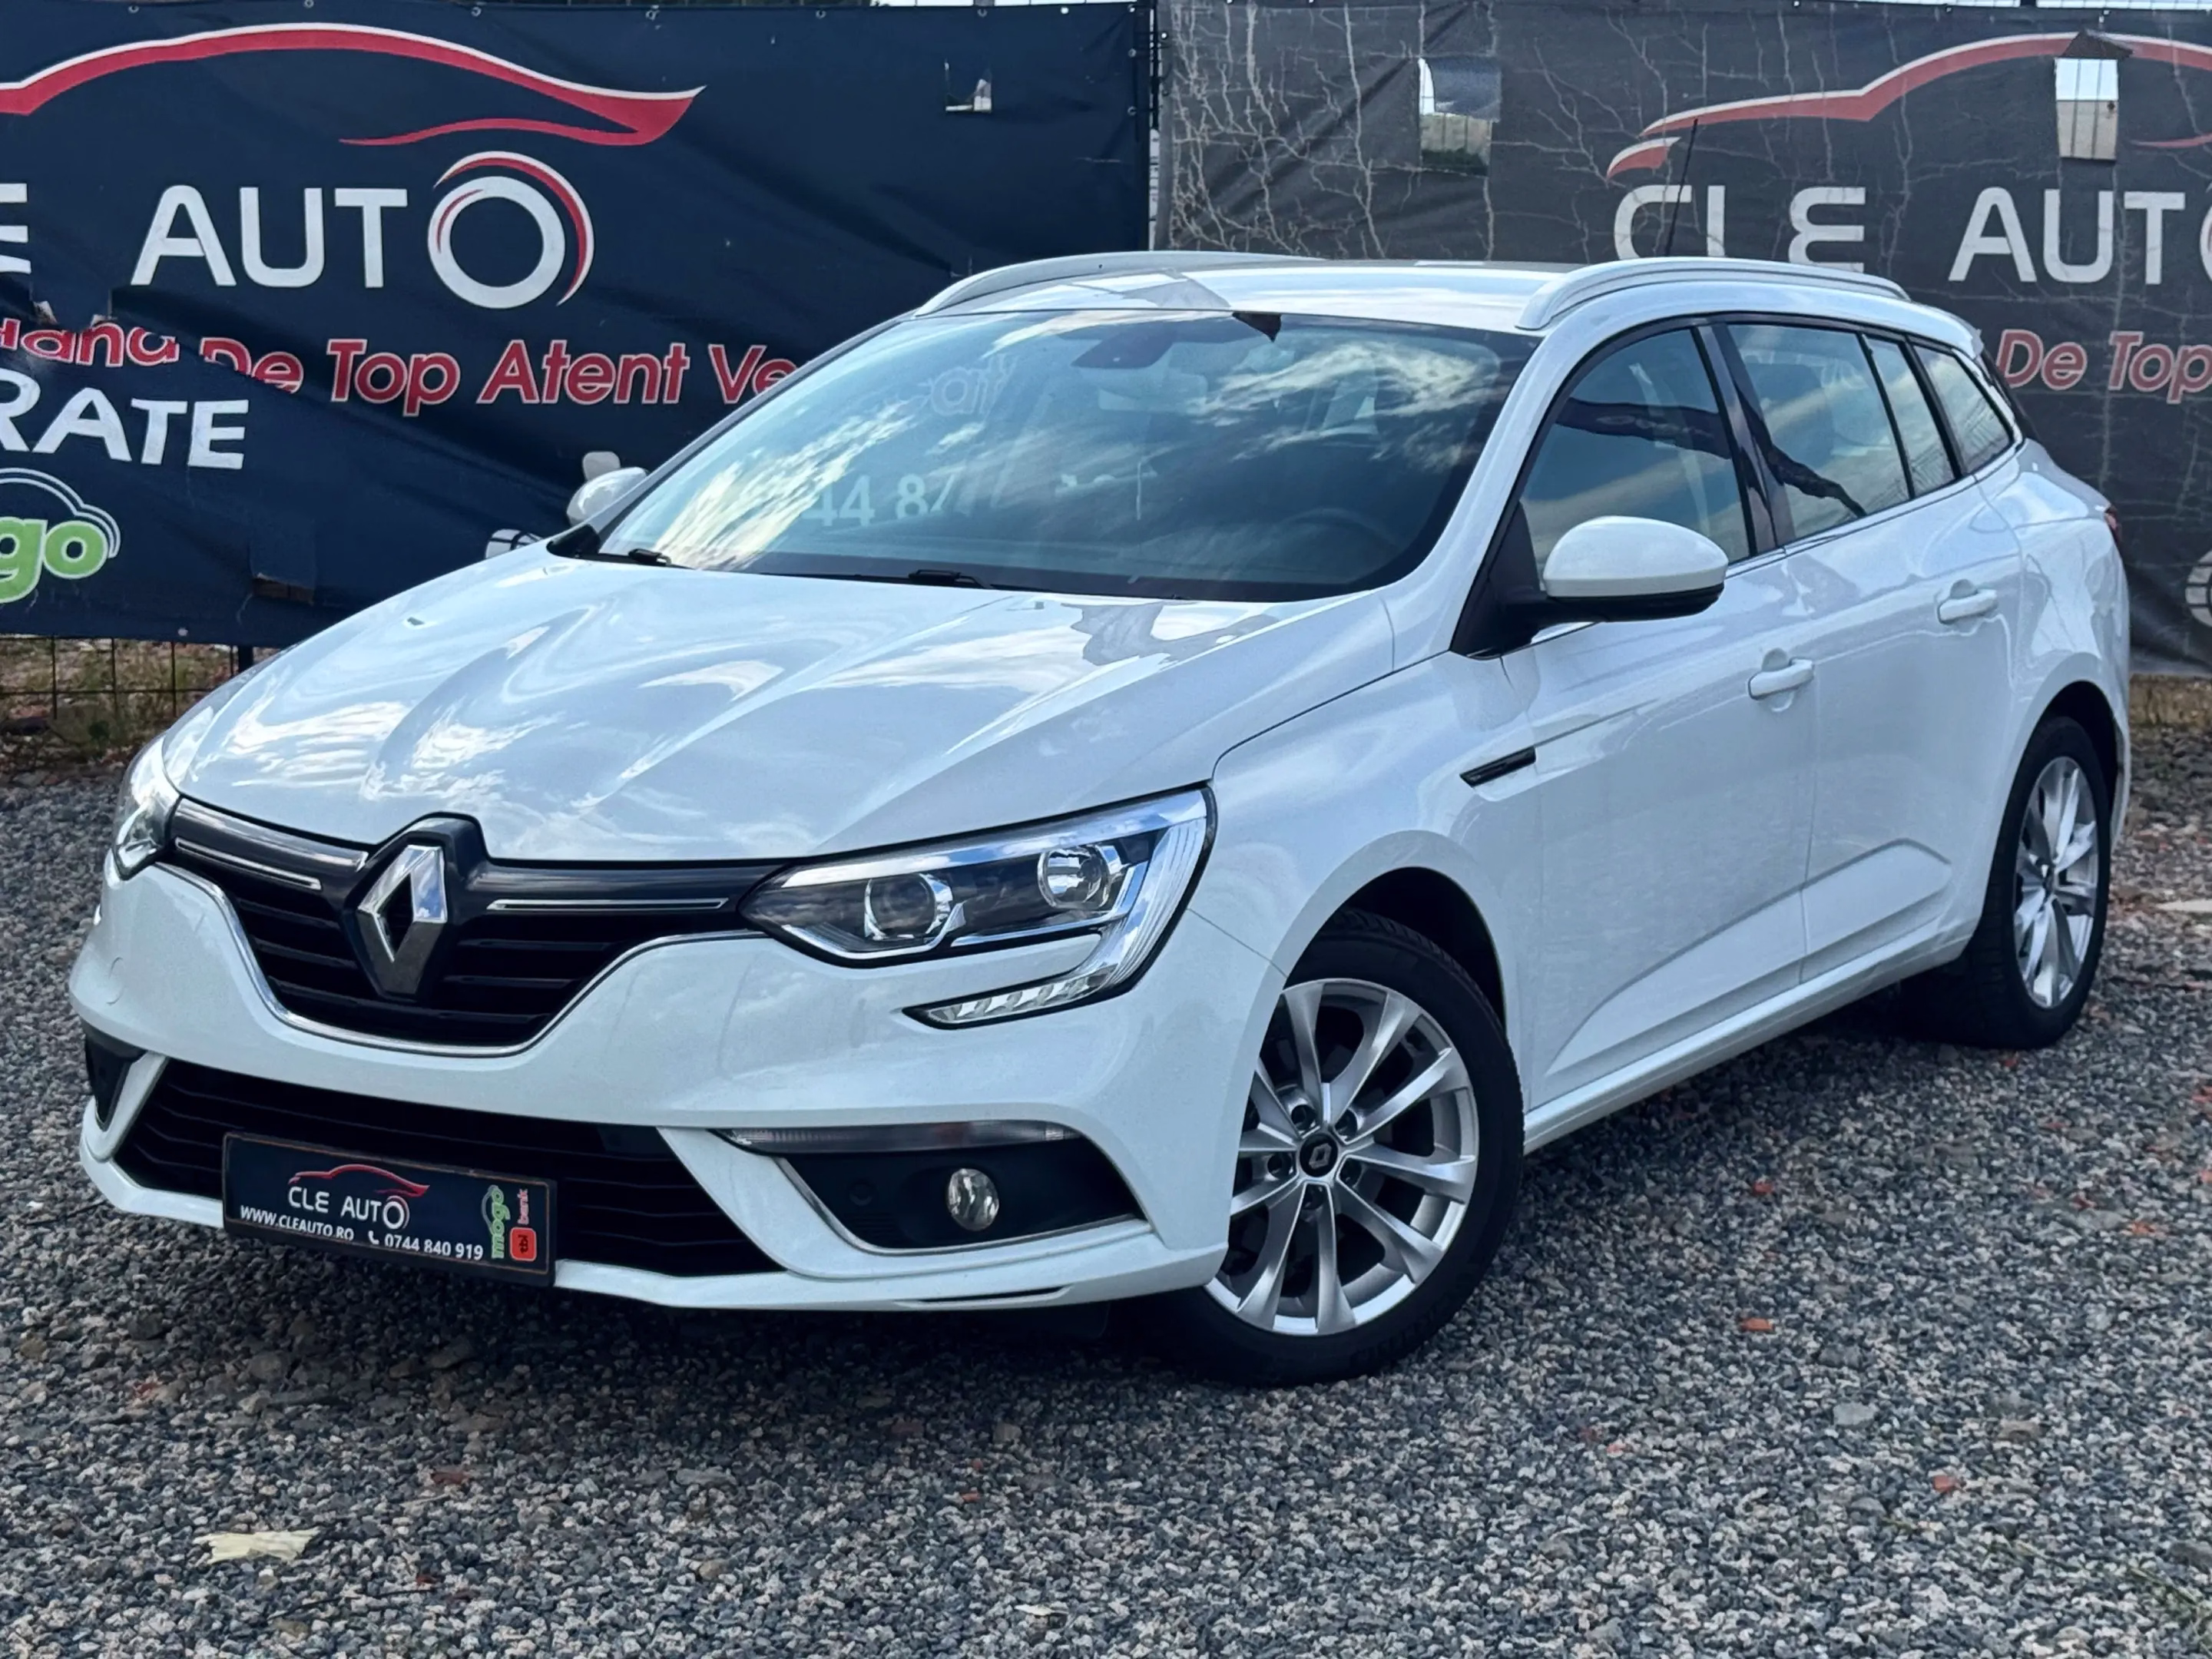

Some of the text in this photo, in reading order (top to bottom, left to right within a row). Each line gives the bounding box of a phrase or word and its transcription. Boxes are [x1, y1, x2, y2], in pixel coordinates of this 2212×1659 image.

[131, 176, 566, 309] AUTO
[1948, 187, 2212, 284] AUT
[326, 338, 461, 417] Top
[475, 339, 690, 404] Atent
[1997, 329, 2212, 405] De Top
[288, 1186, 405, 1230] CLE AUTO
[491, 1187, 511, 1259] mogo
[384, 1233, 484, 1261] 0744 840 919
